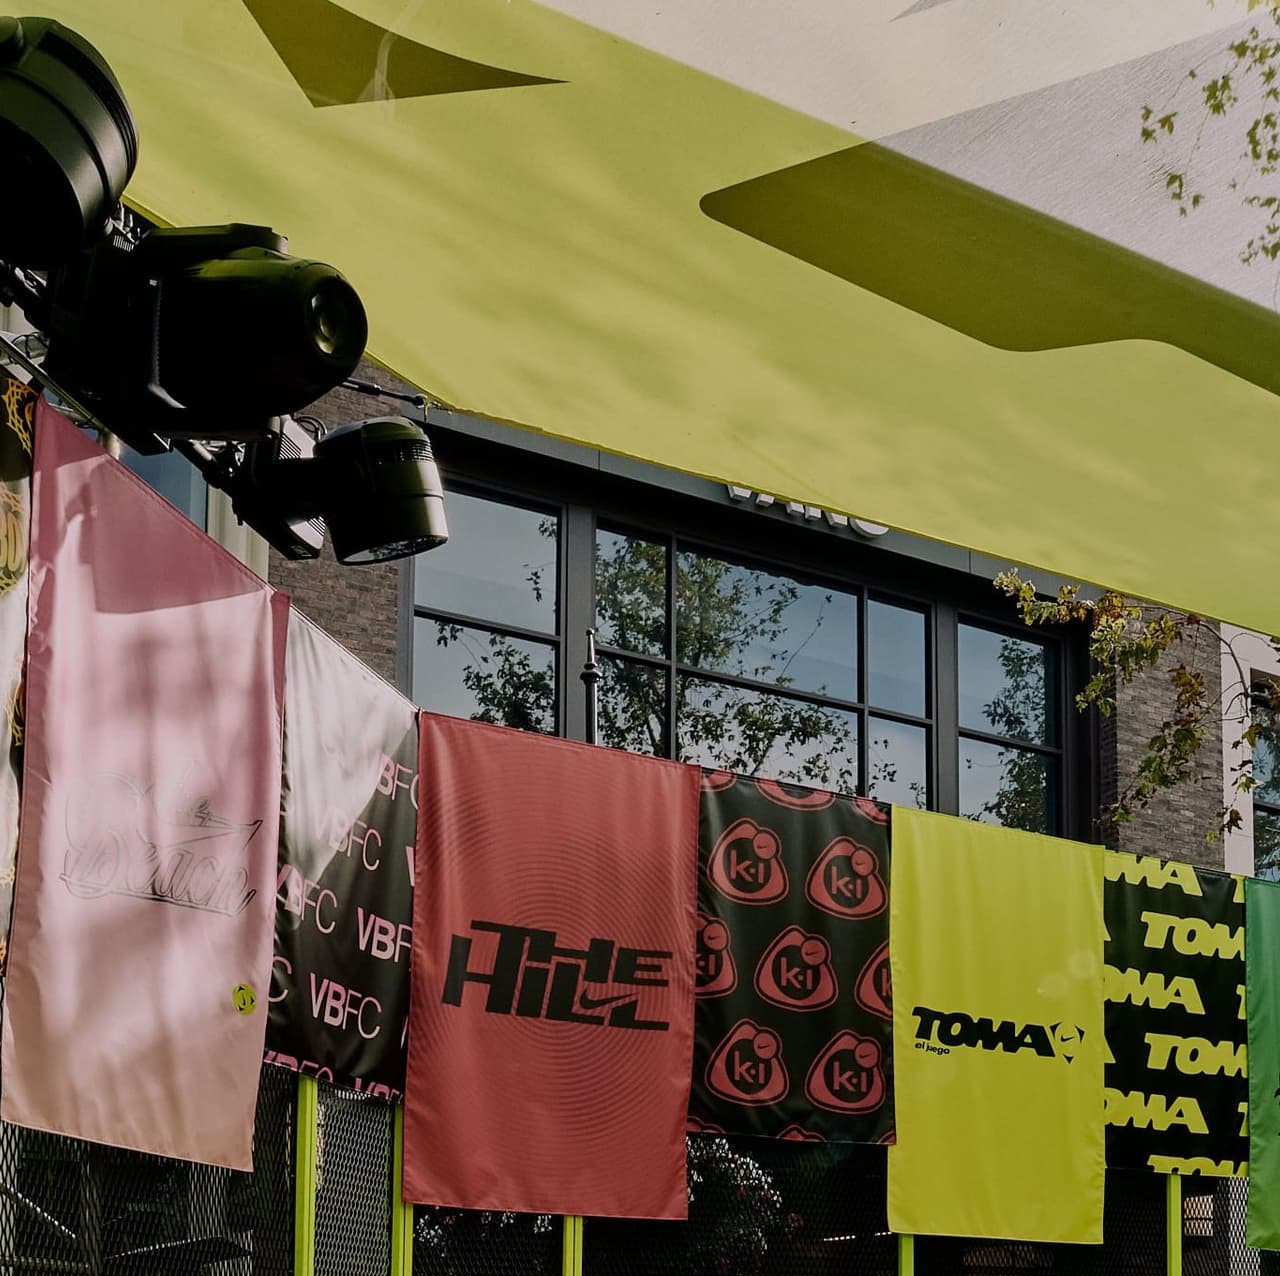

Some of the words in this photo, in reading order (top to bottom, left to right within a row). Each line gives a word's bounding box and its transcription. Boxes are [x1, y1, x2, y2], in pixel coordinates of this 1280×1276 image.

[356, 907, 412, 963] VBF
[470, 920, 674, 987] THE
[1141, 911, 1245, 962] TOM
[309, 972, 382, 1039] VBFC
[1104, 965, 1206, 1015] OMA
[912, 1006, 1056, 1057] TOMA
[915, 1042, 925, 1051] el
[926, 1043, 951, 1055] juego
[1145, 1032, 1248, 1078] TOM
[1104, 1087, 1209, 1134] OMA
